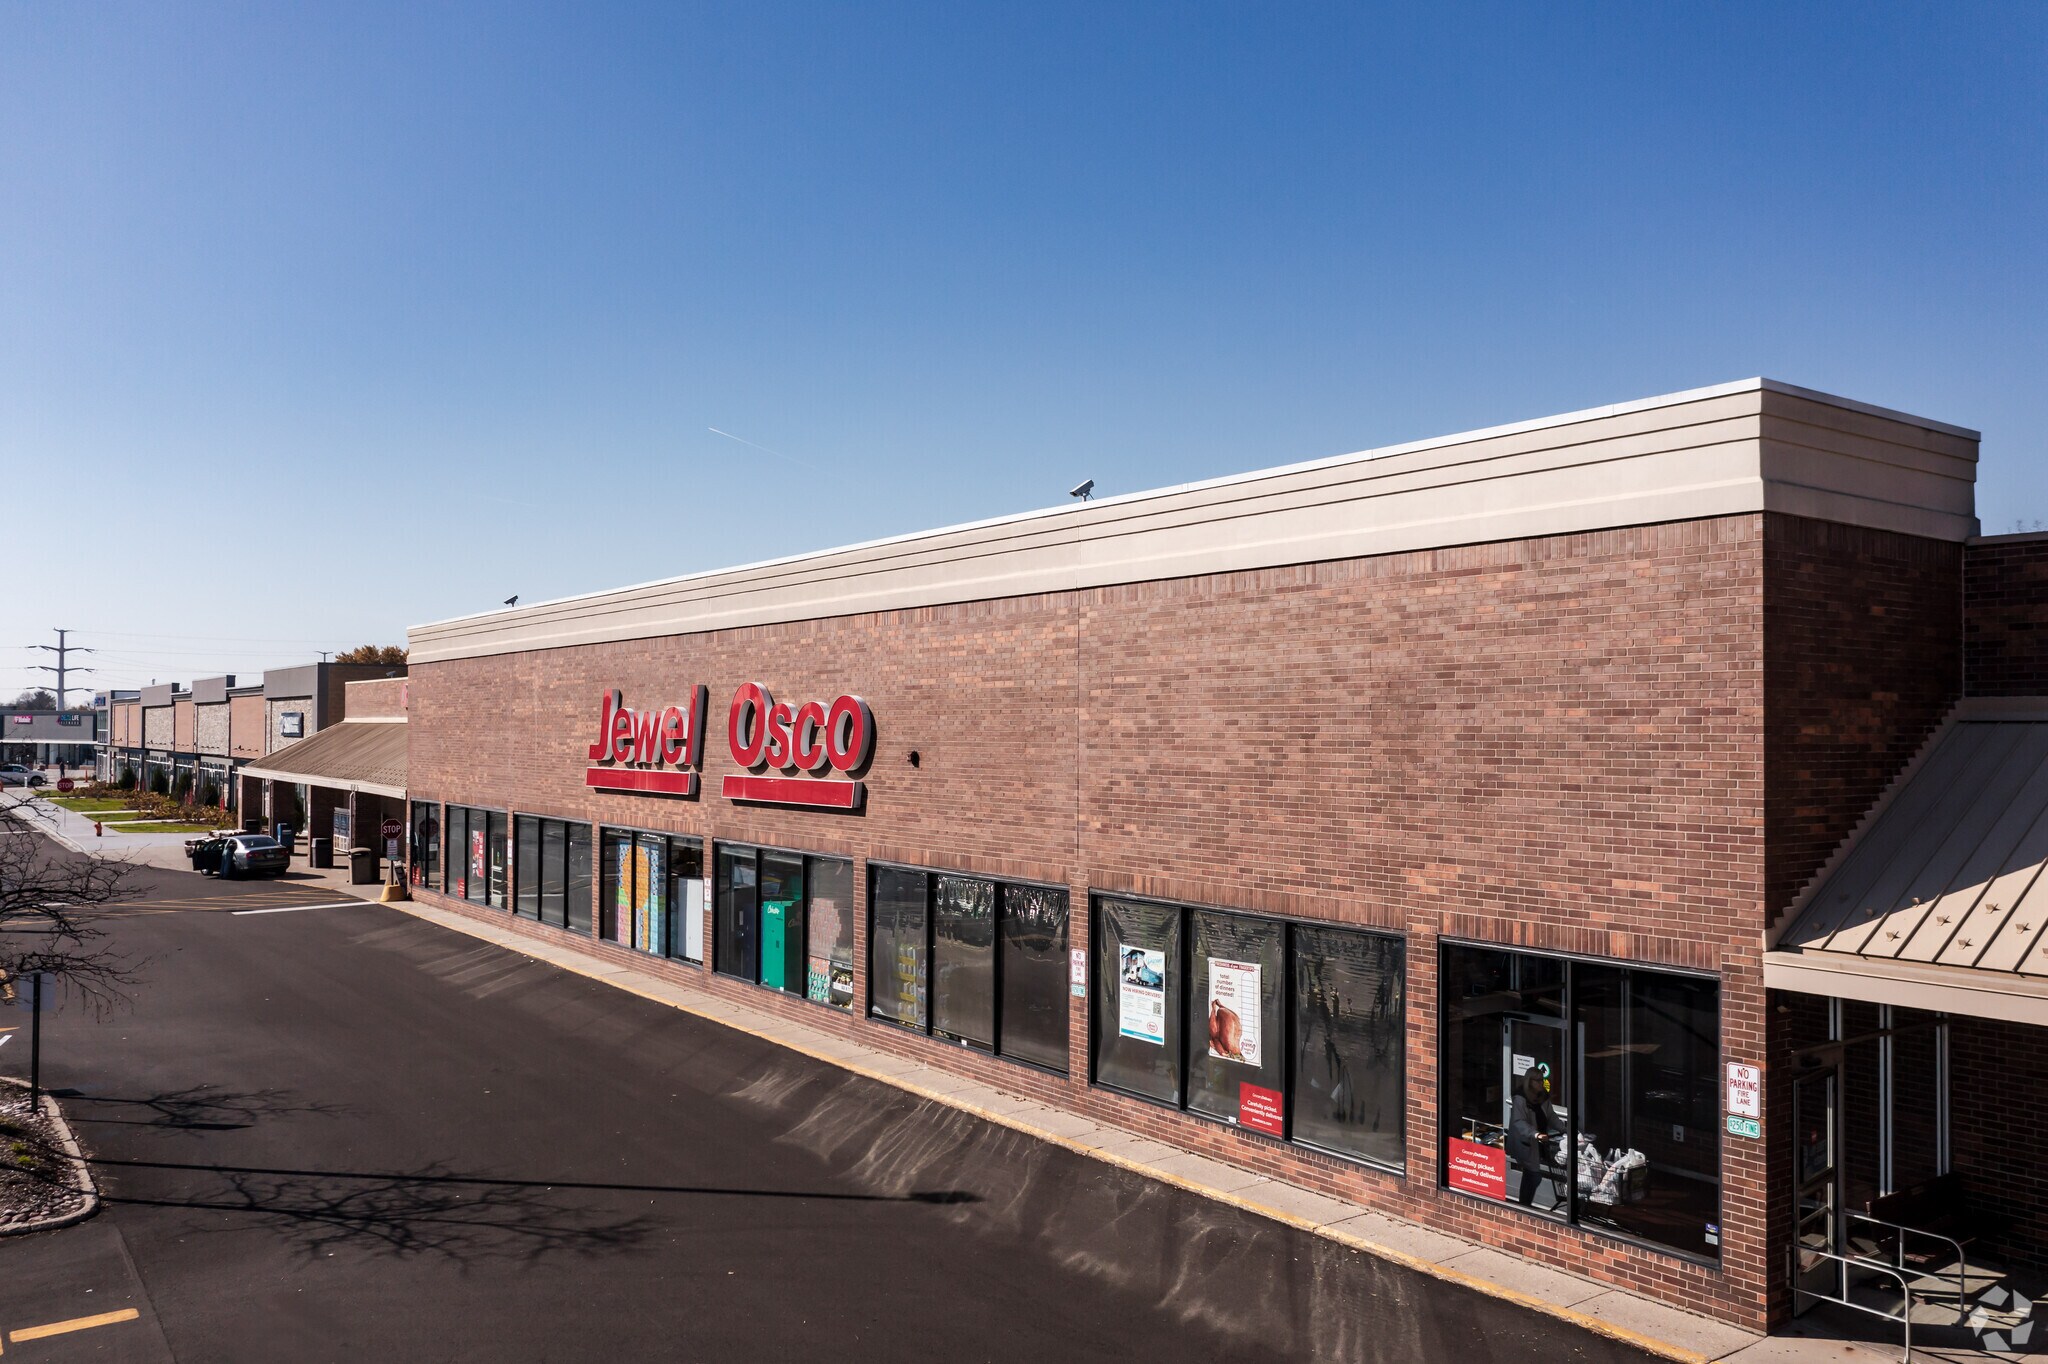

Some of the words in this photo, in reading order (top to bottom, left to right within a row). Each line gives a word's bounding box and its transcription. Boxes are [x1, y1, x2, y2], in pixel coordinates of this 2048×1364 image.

[589, 684, 706, 765] Jewel
[728, 681, 871, 771] Osco
[383, 825, 401, 834] STOP
[1132, 988, 1145, 996] HIRING
[1737, 1069, 1749, 1079] NO
[1729, 1078, 1757, 1092] PARKING
[1737, 1090, 1749, 1098] FIRE
[1247, 1100, 1264, 1110] Carefully
[1736, 1098, 1751, 1106] LANE
[1730, 1120, 1744, 1131] $250
[1745, 1122, 1757, 1134] FINE
[1455, 1156, 1477, 1168] Carefully
[1478, 1163, 1495, 1172] picked.
[1480, 1171, 1504, 1182] delivered.
